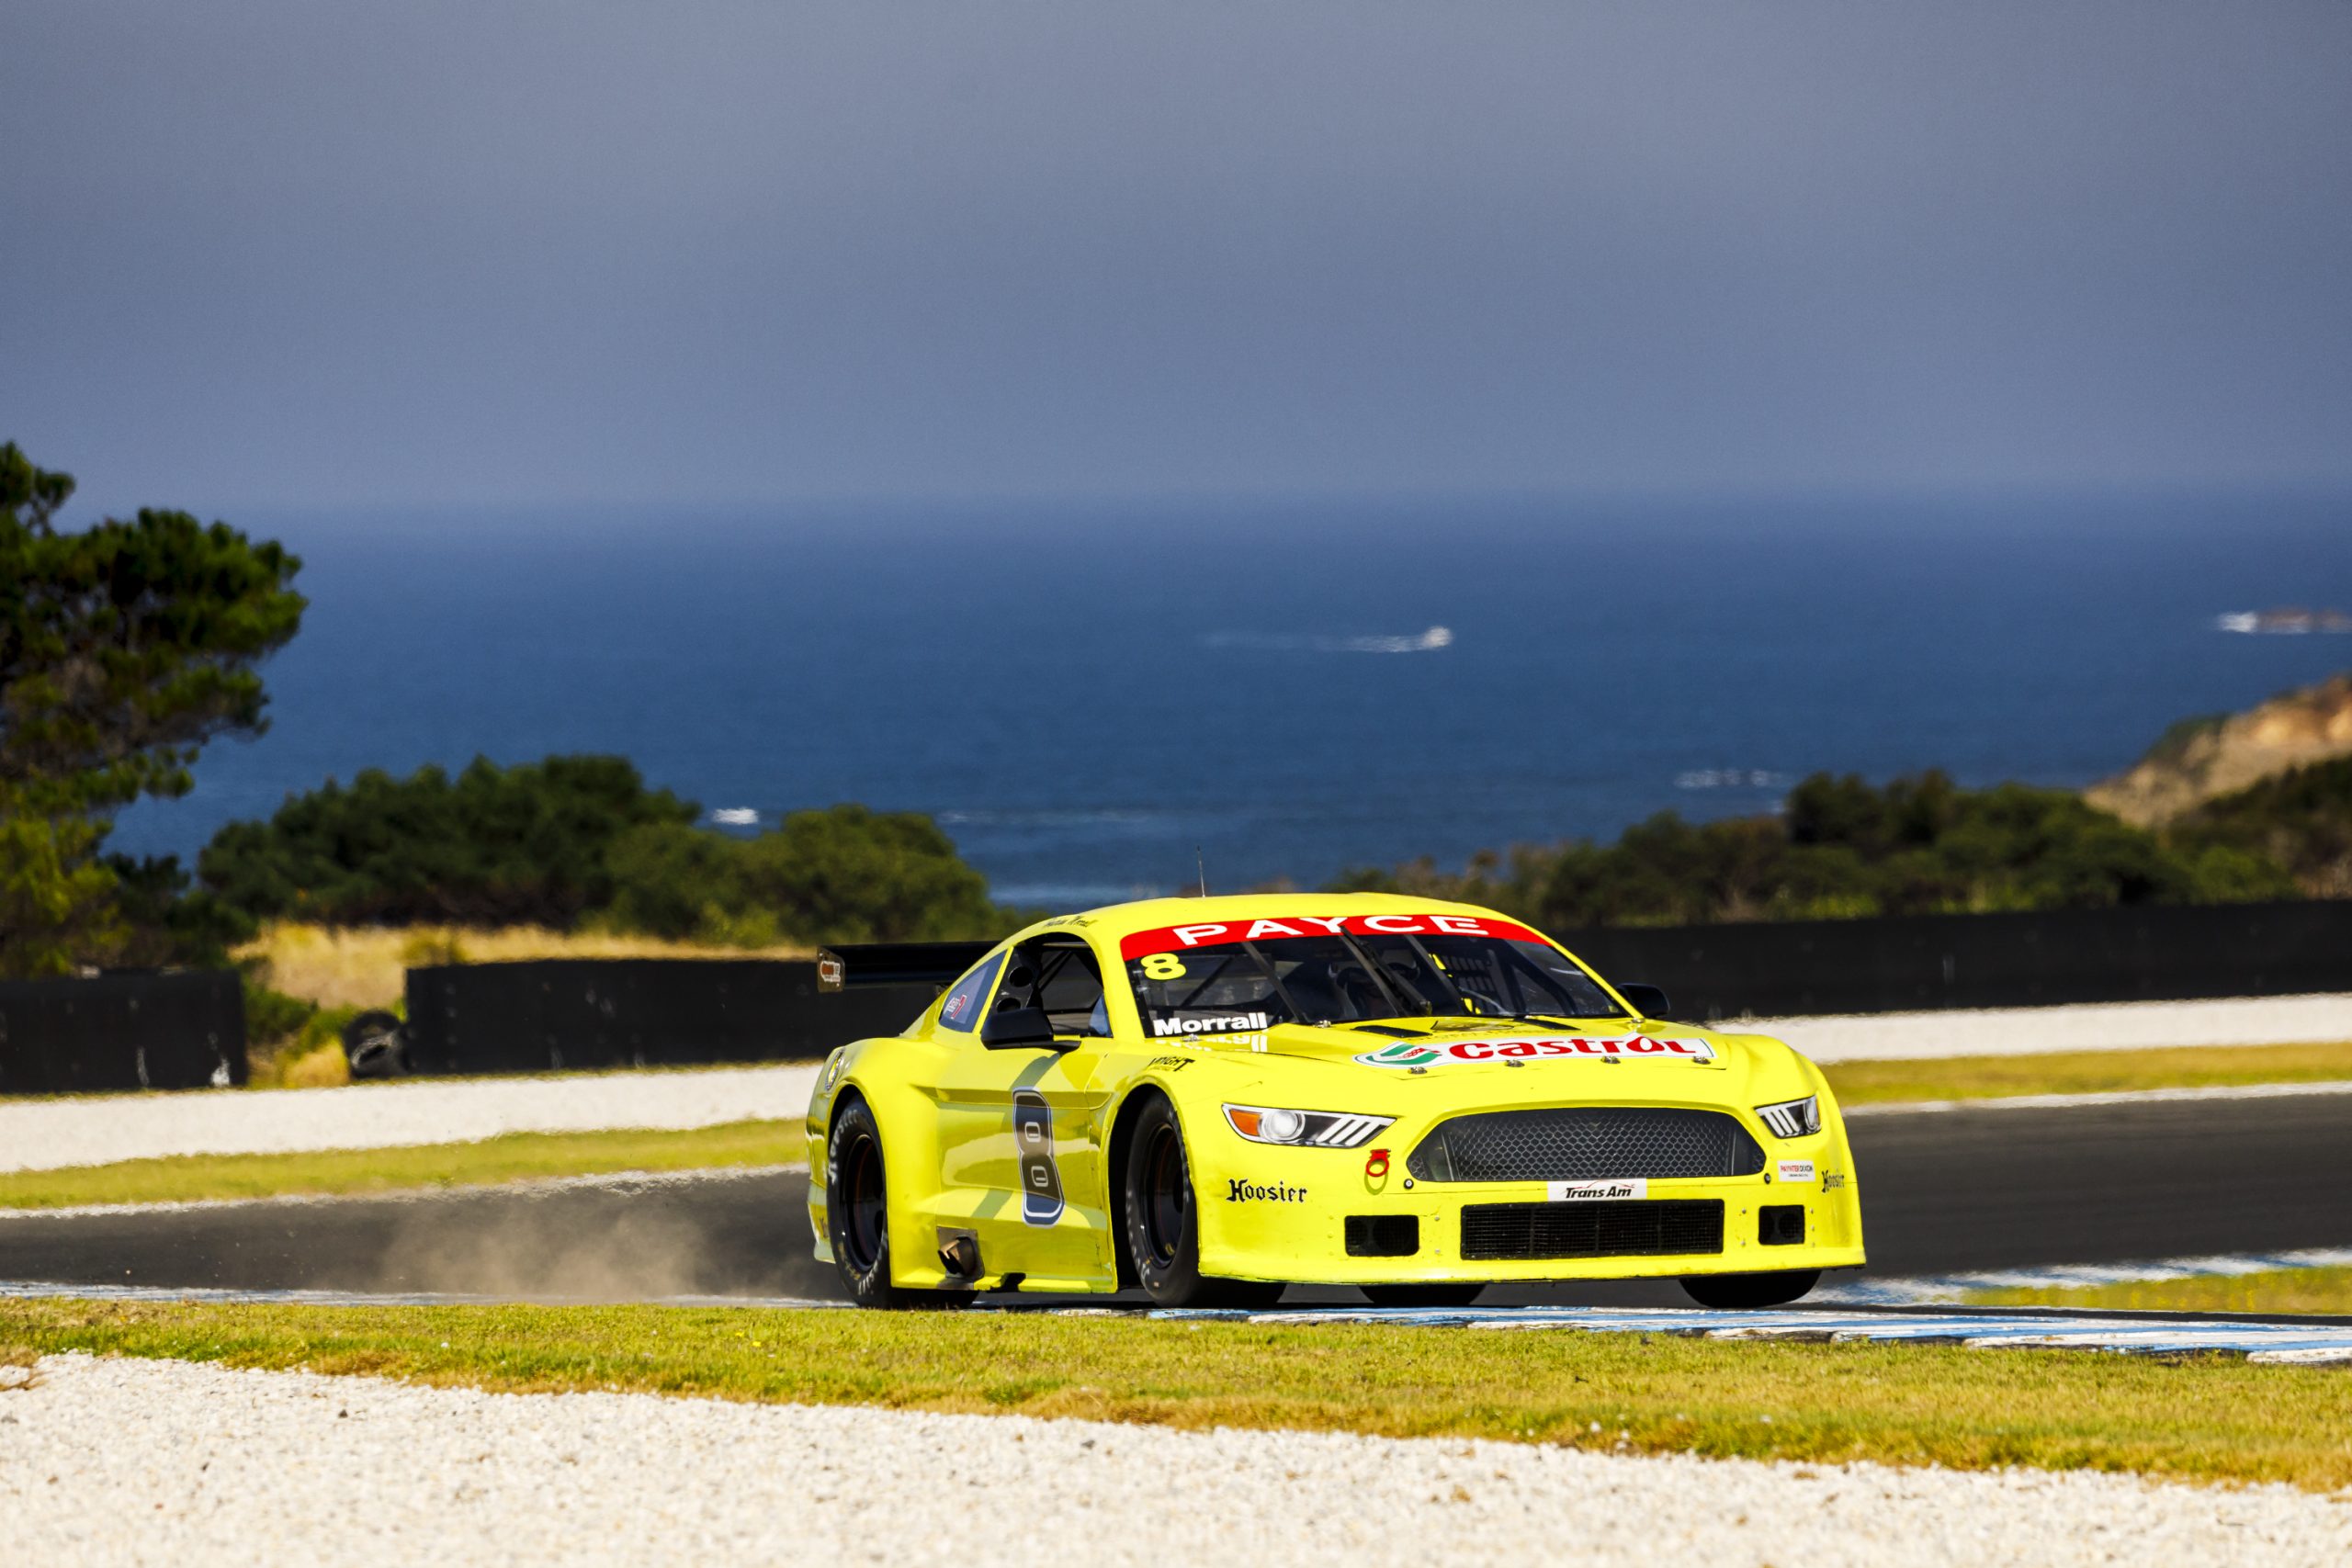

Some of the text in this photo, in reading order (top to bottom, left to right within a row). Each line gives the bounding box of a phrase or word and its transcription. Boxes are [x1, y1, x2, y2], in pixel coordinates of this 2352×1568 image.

[1172, 915, 1489, 946] PAYCE
[1140, 953, 1187, 980] 8
[1153, 1011, 1268, 1036] Morrall
[1449, 1035, 1696, 1059] Castrol
[1012, 1086, 1066, 1229] 8
[1226, 1179, 1307, 1202] Hoosier
[1566, 1186, 1632, 1199] Trans Am
